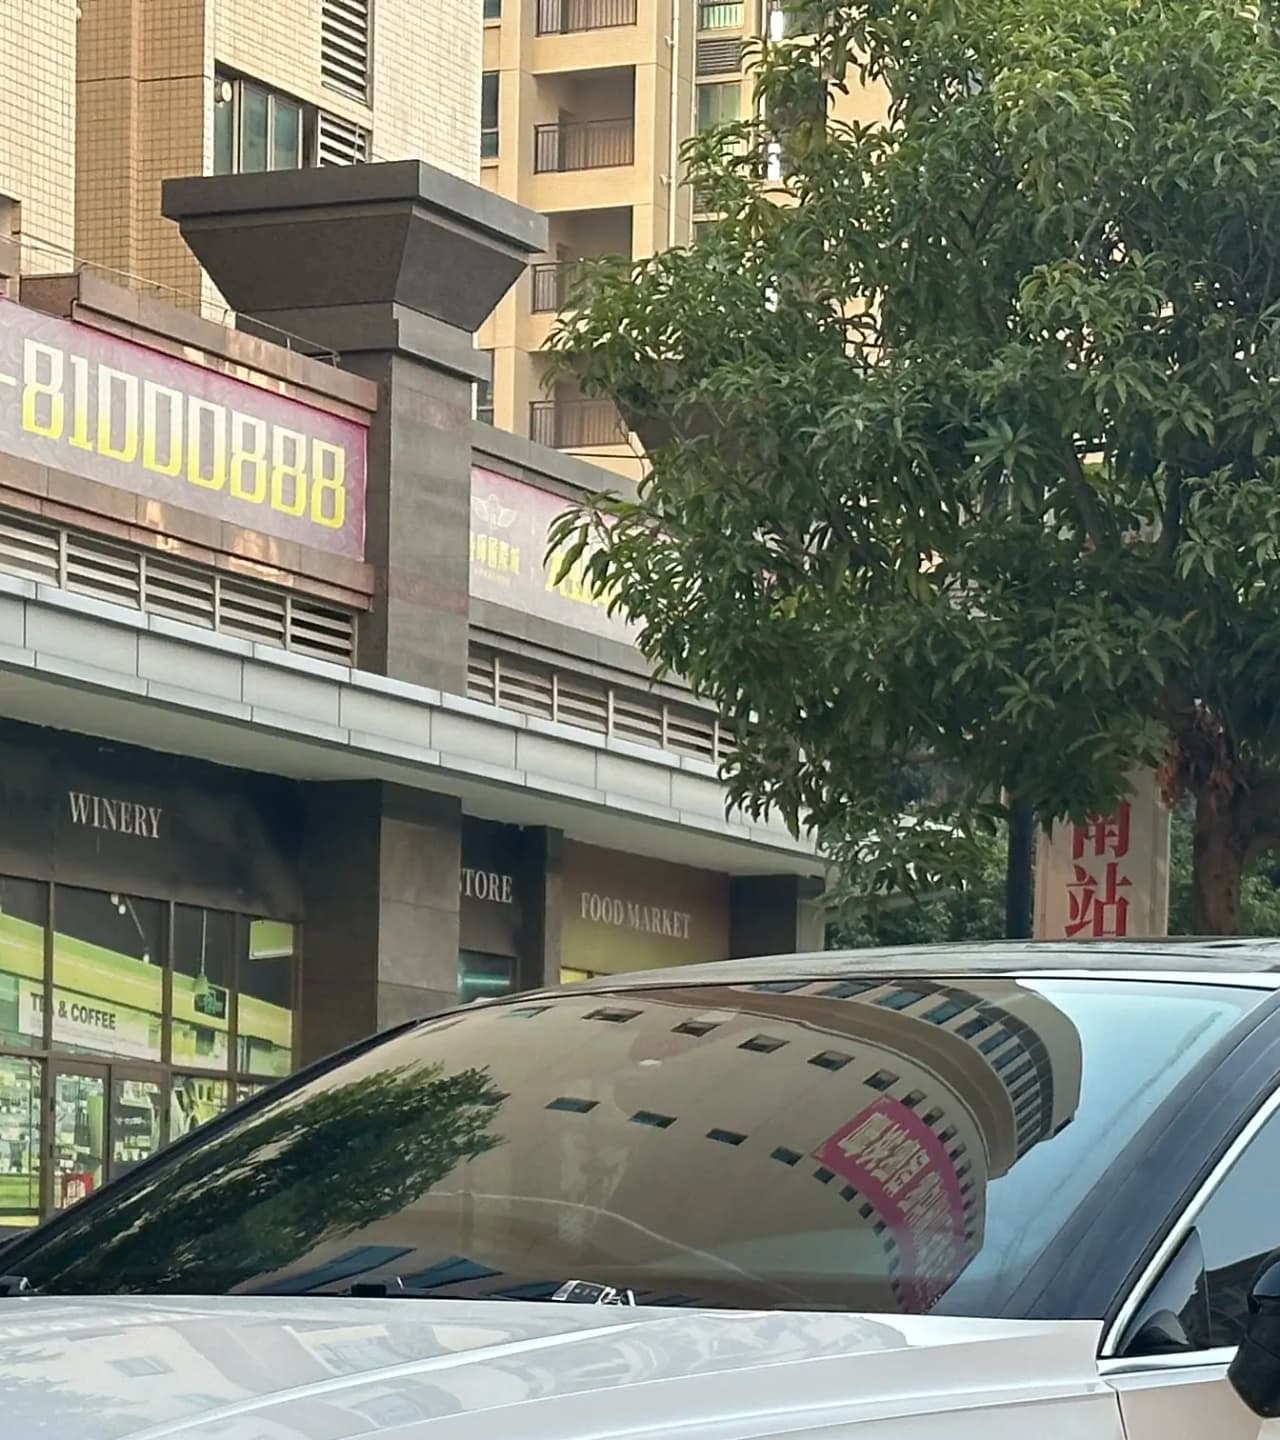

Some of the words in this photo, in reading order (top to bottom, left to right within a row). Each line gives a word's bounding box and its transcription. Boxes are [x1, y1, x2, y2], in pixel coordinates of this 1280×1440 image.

[68, 791, 163, 839] WINERY
[459, 867, 513, 904] TORE
[580, 891, 624, 926] FOOD
[626, 900, 692, 940] MARKET
[70, 1003, 117, 1031] COFFEE
